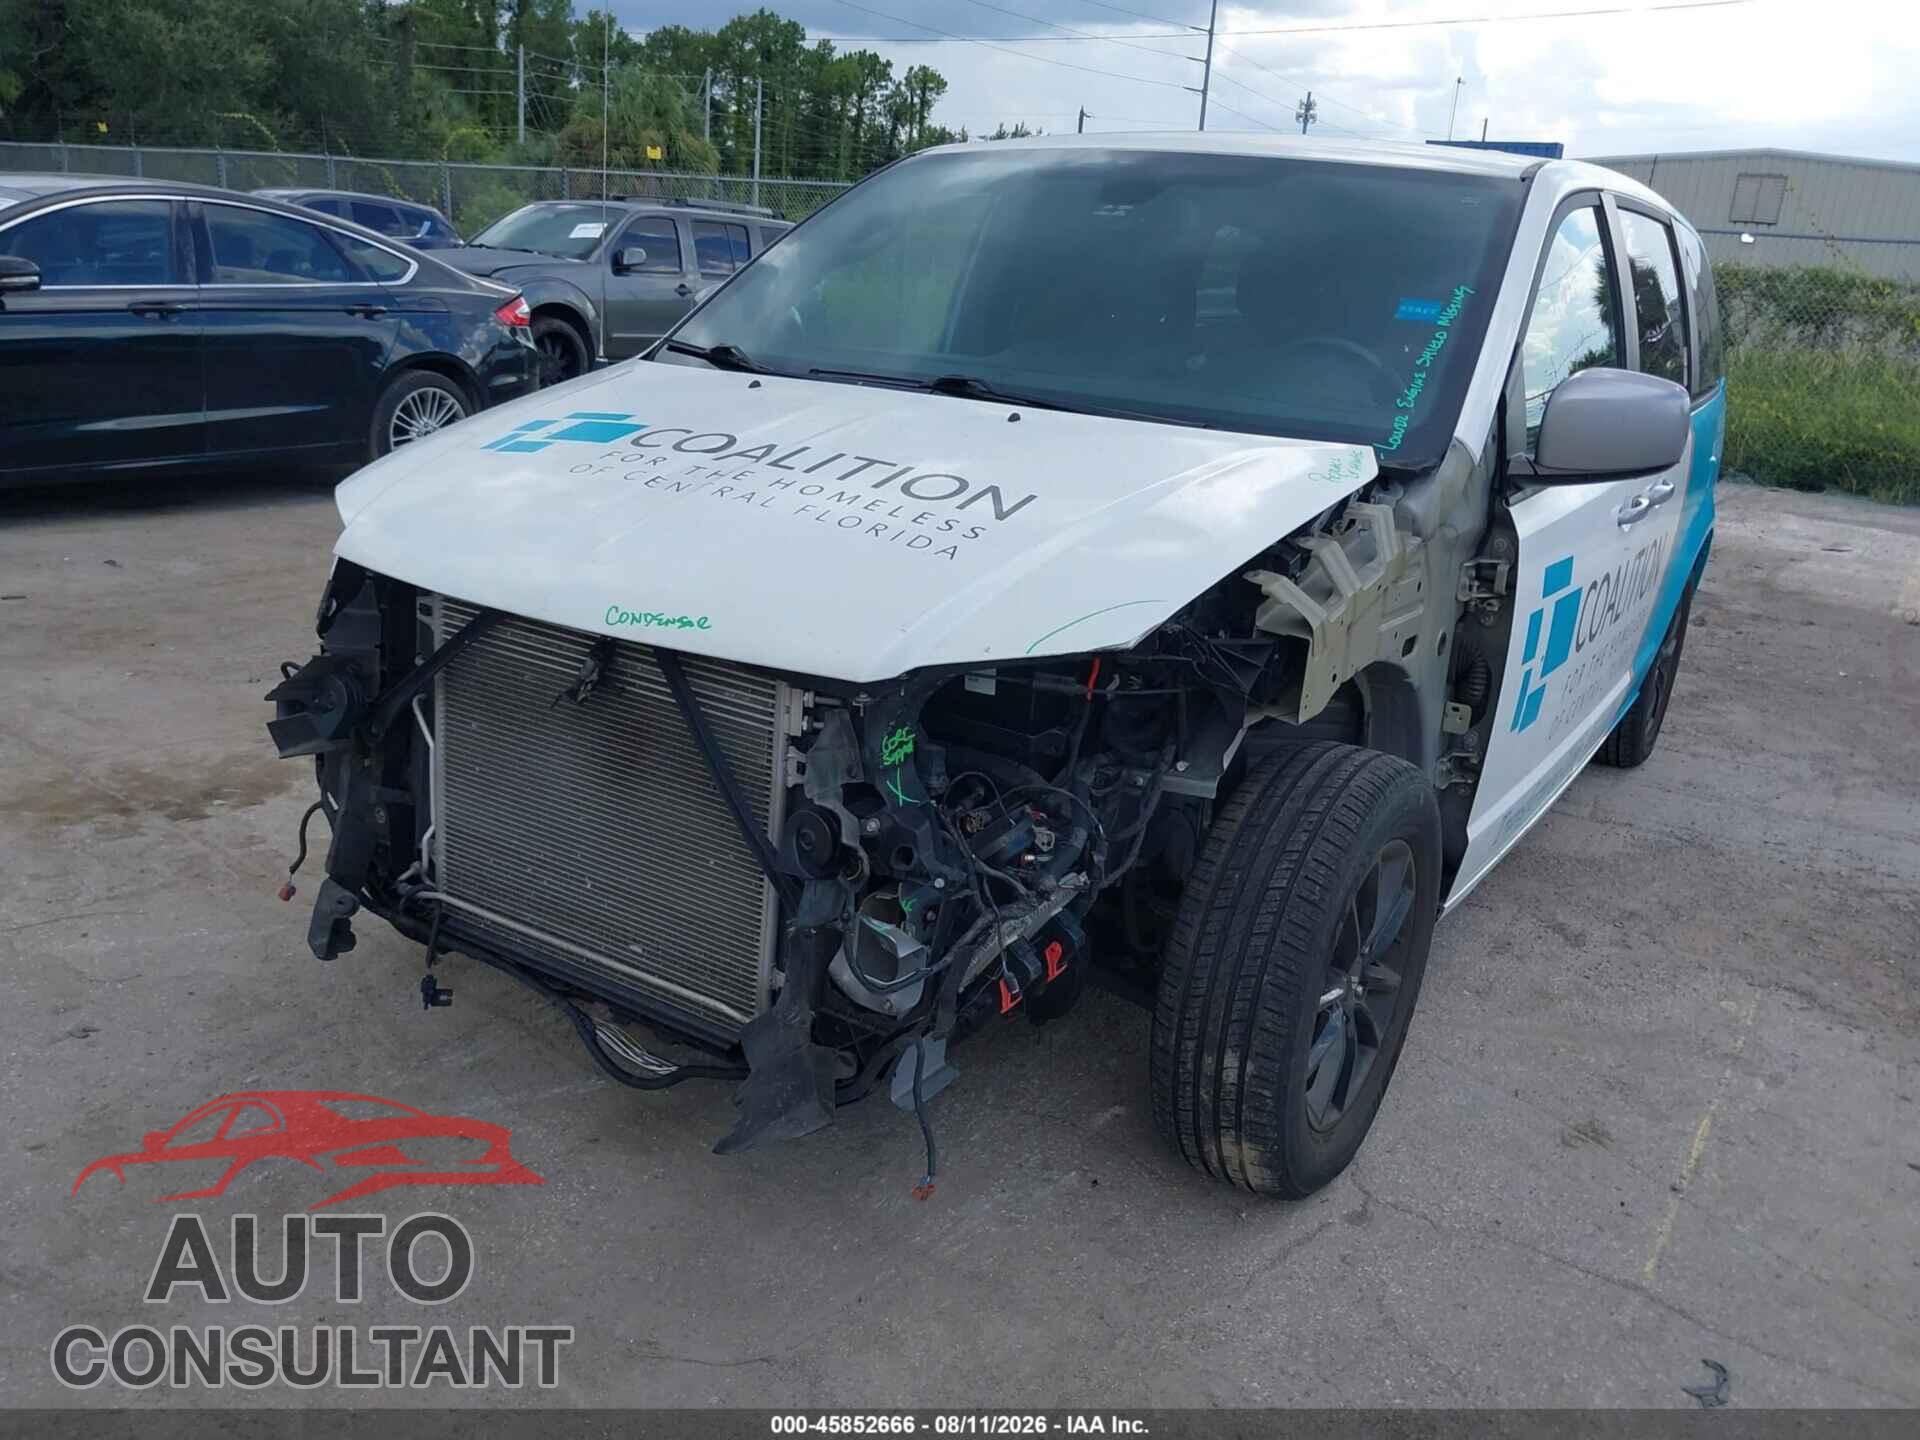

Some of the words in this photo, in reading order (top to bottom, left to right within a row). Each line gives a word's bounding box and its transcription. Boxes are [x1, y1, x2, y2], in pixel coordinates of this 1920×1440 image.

[569, 463, 615, 476] OF
[623, 470, 776, 508] CENTRAL
[793, 504, 958, 561] FLORIDA
[597, 450, 668, 466] FOR
[683, 465, 756, 481] THE
[768, 478, 987, 540] HOMELESS
[630, 428, 1038, 521] COALITION
